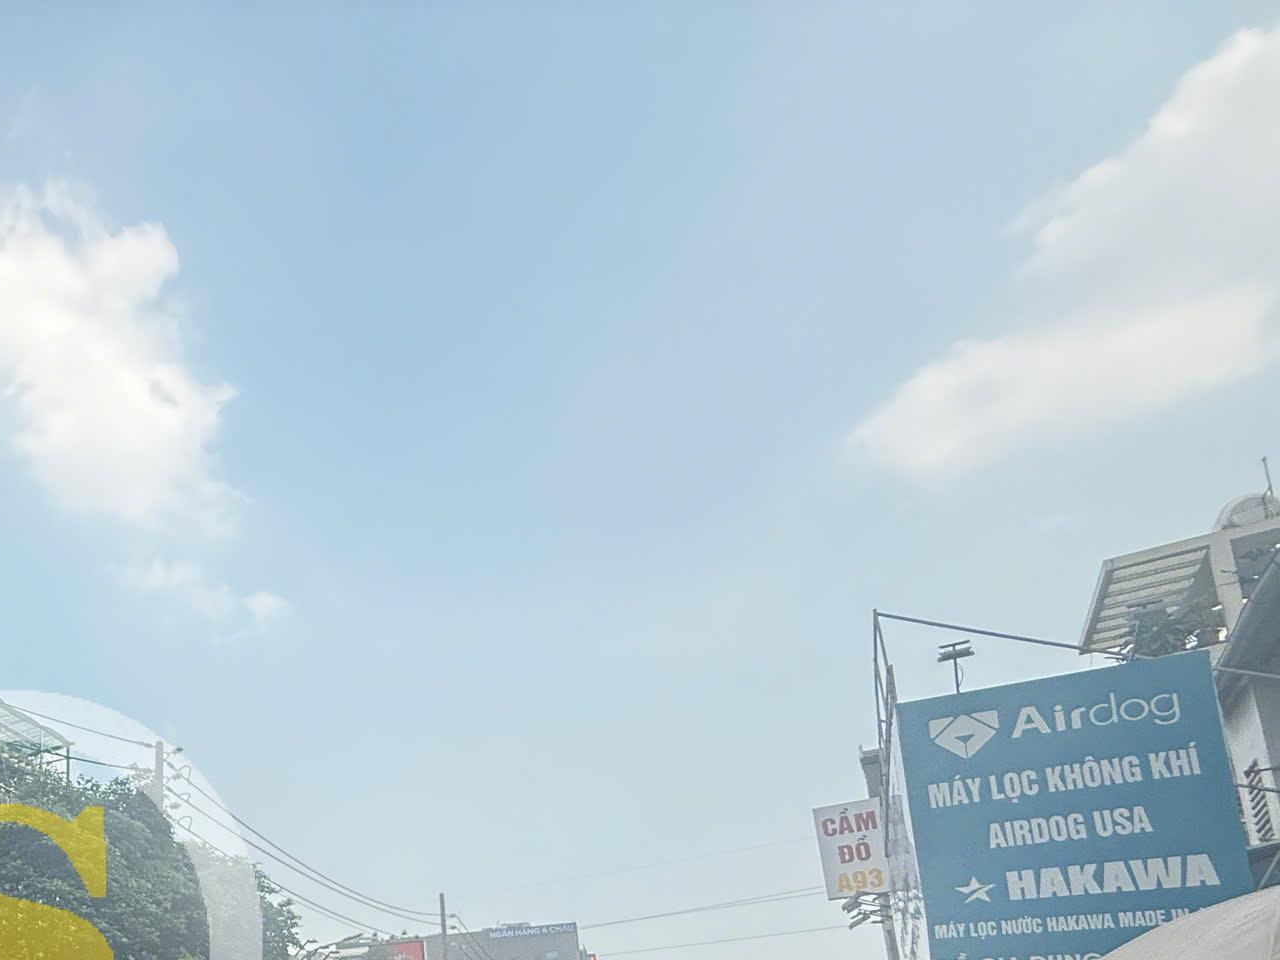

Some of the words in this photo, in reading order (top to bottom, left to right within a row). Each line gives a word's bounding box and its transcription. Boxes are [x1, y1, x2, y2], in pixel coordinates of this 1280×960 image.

[1011, 692, 1182, 738] Airdog
[928, 775, 980, 809] MÁY
[989, 772, 1039, 803] LỌC
[1047, 755, 1143, 793] KHÔNG
[1148, 742, 1201, 780] KHÍ
[821, 808, 877, 838] CẦM
[989, 814, 1087, 848] AIRDOG
[1094, 806, 1154, 838] USA
[837, 834, 872, 864] ĐỒ
[837, 868, 885, 893] A93
[1006, 853, 1220, 901] HAKAWA
[934, 922, 966, 940] MÁY
[969, 921, 997, 940] LỌC
[1000, 916, 1043, 936] NƯỚC
[1046, 912, 1115, 933] HAKAWA
[1118, 910, 1166, 929] MADE
